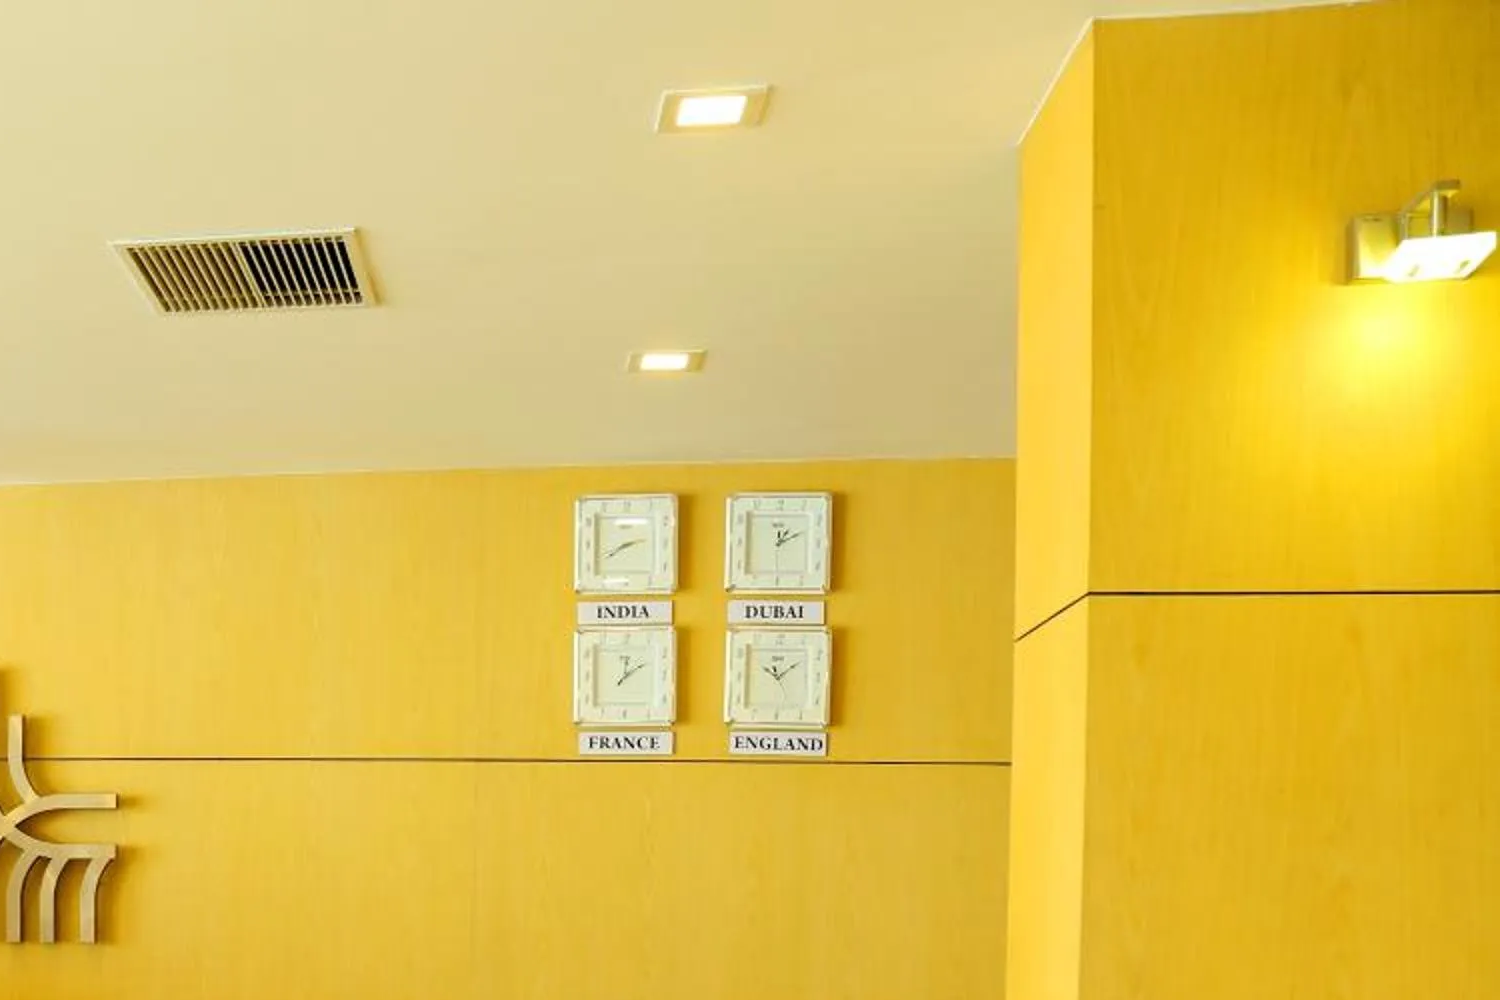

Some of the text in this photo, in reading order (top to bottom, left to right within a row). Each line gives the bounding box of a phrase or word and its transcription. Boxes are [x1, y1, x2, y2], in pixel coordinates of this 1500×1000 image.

[597, 605, 650, 619] INDIA
[745, 605, 805, 619] DUBAI
[588, 736, 661, 750] FRANCE
[734, 735, 824, 751] ENGLAND
